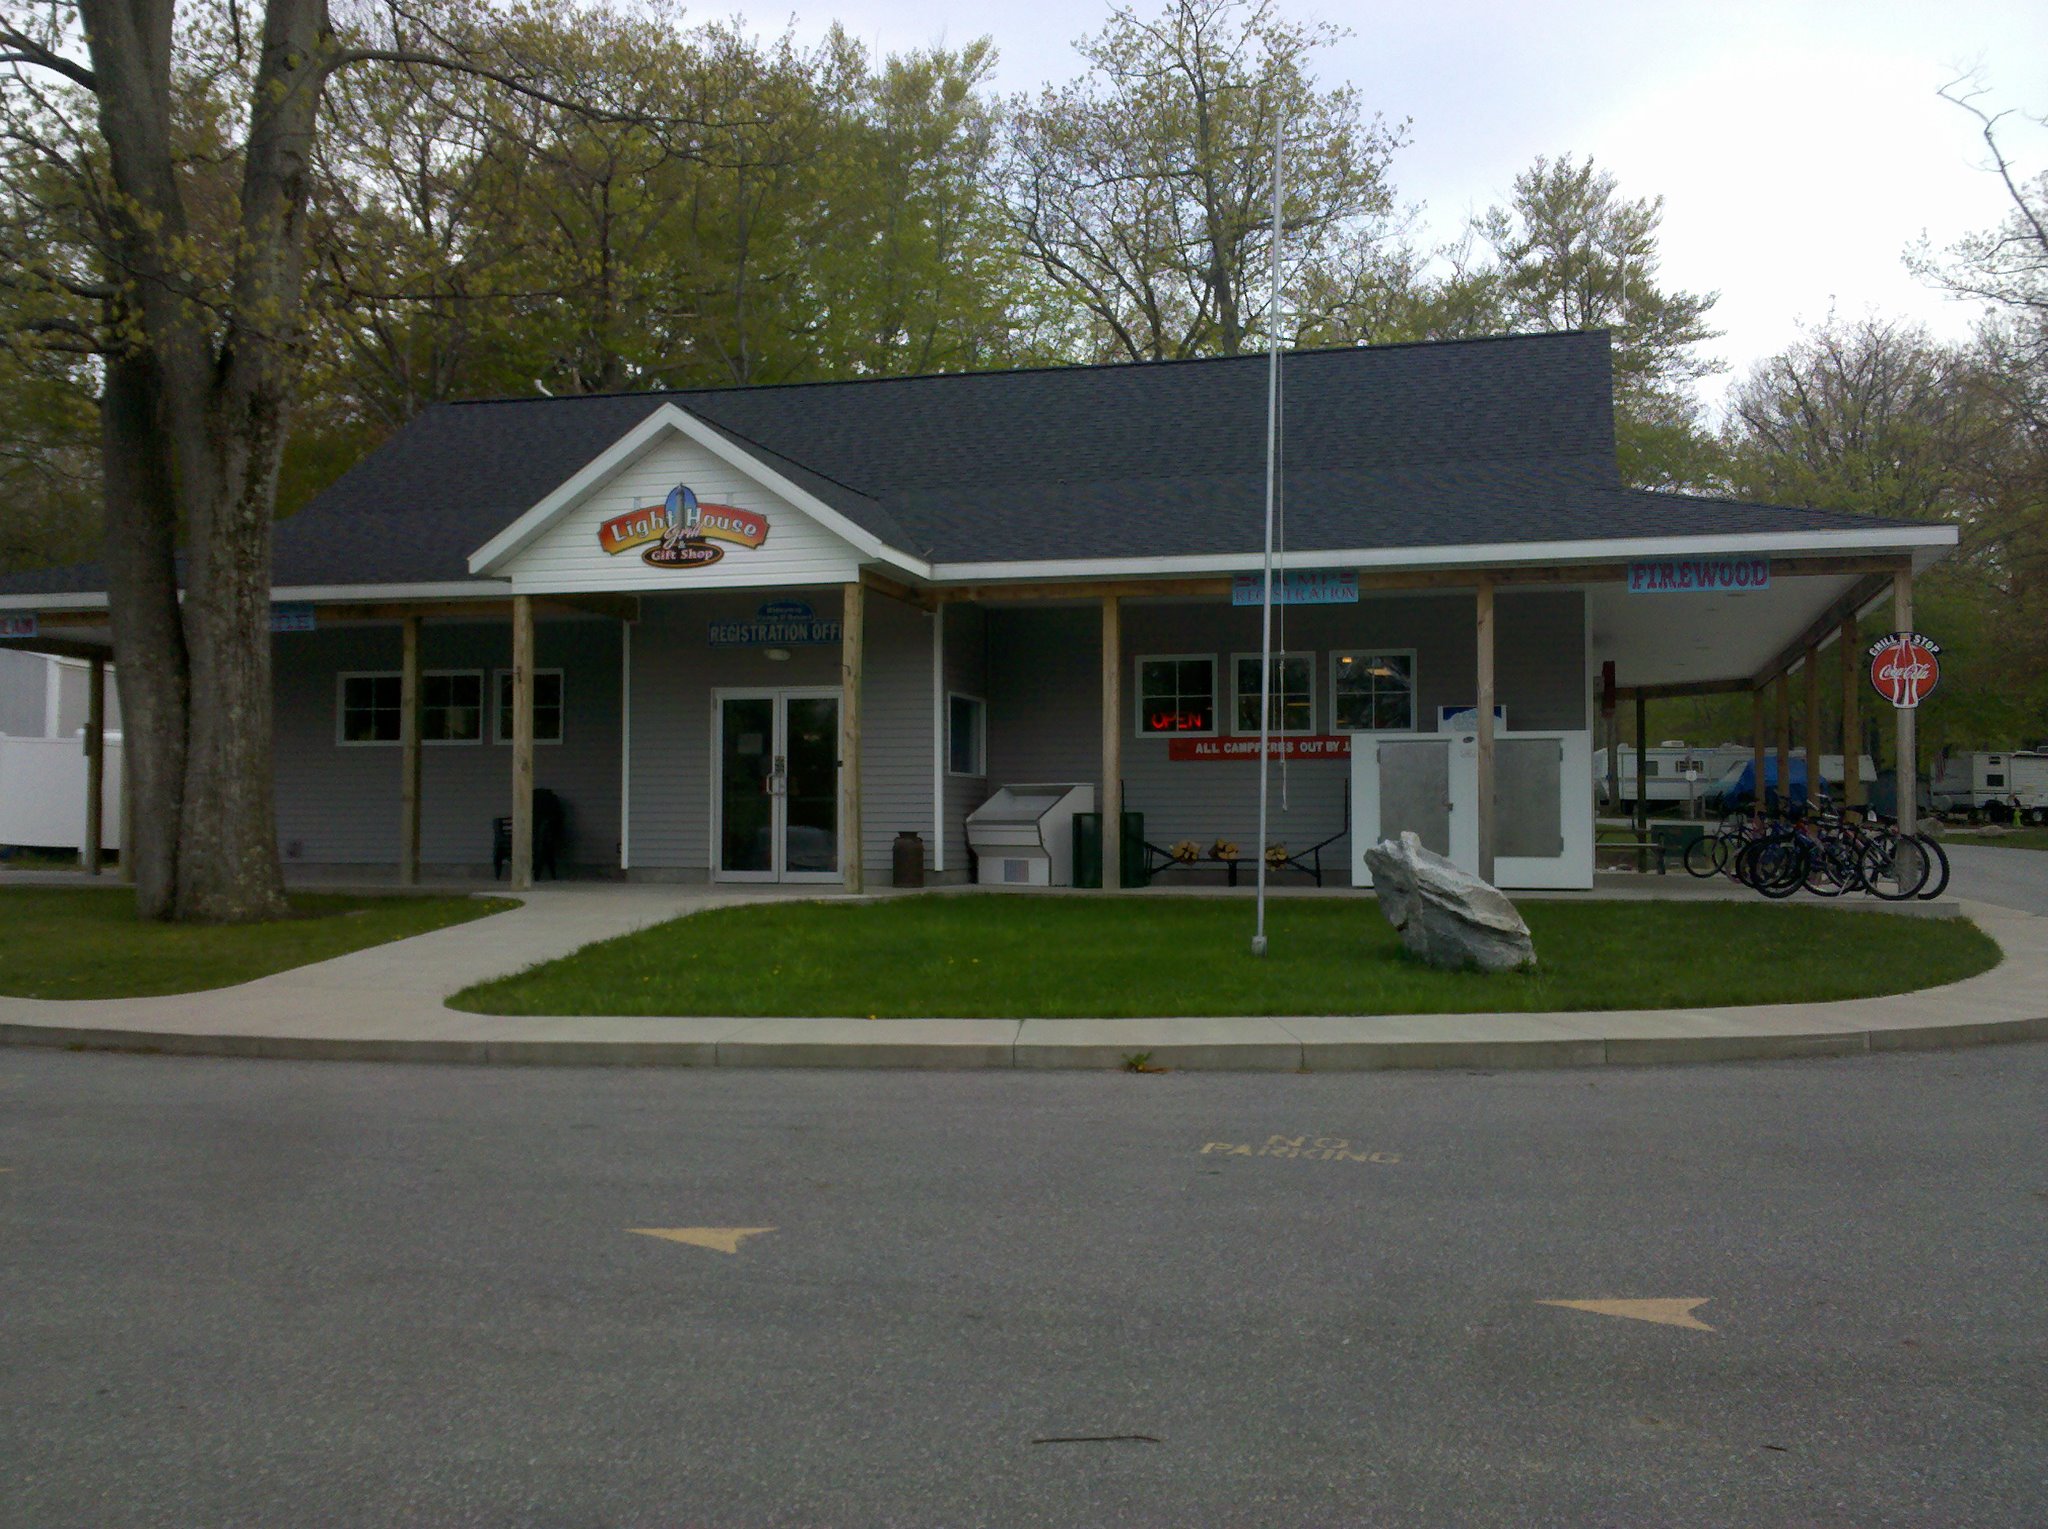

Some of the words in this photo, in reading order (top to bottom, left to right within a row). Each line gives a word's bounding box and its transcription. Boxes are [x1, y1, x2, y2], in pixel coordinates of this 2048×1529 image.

[611, 508, 674, 543] Light
[685, 507, 757, 538] House
[662, 521, 704, 550] Grill
[650, 549, 677, 562] Gift
[679, 548, 714, 561] Shop
[1631, 559, 1768, 590] FIREWOOD
[1235, 586, 1356, 602] REGSTRATION
[709, 624, 808, 643] REGISTRATION
[1869, 634, 1898, 657] CHILL
[1913, 634, 1940, 653] STOP
[1152, 713, 1202, 729] OPEN
[1195, 742, 1221, 755] ALL
[1299, 741, 1324, 753] OUT
[1325, 741, 1340, 753] BY
[1267, 1134, 1349, 1149] NO
[1200, 1142, 1400, 1164] PARKING
